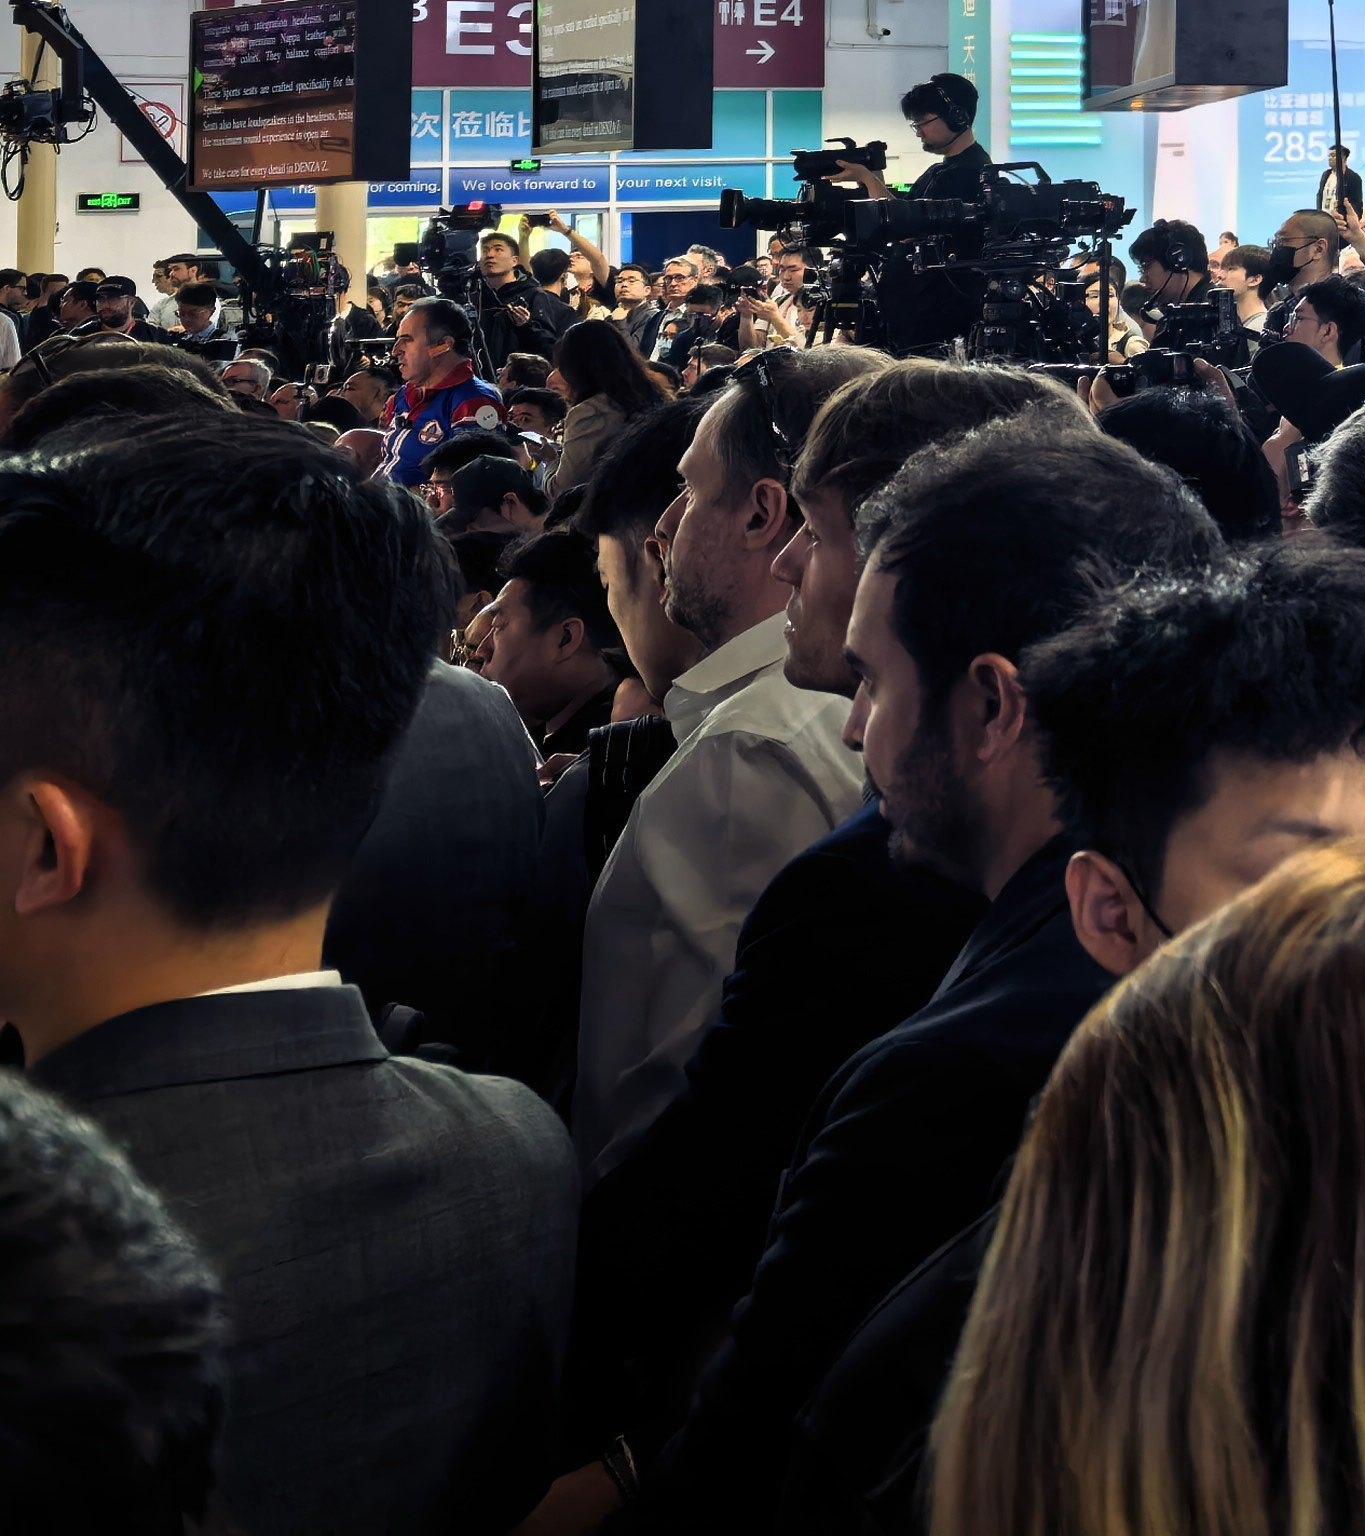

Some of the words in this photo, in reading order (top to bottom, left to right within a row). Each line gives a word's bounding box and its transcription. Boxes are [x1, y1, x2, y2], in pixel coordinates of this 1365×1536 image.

[265, 50, 281, 63] They
[303, 130, 319, 143] open
[294, 160, 319, 174] DENZA
[387, 181, 441, 194] coming.
[462, 179, 486, 191] We
[490, 178, 521, 191] look
[524, 177, 580, 190] forward
[582, 177, 597, 190] to
[616, 178, 652, 190] your
[655, 176, 688, 188] next
[691, 175, 728, 188] visit.
